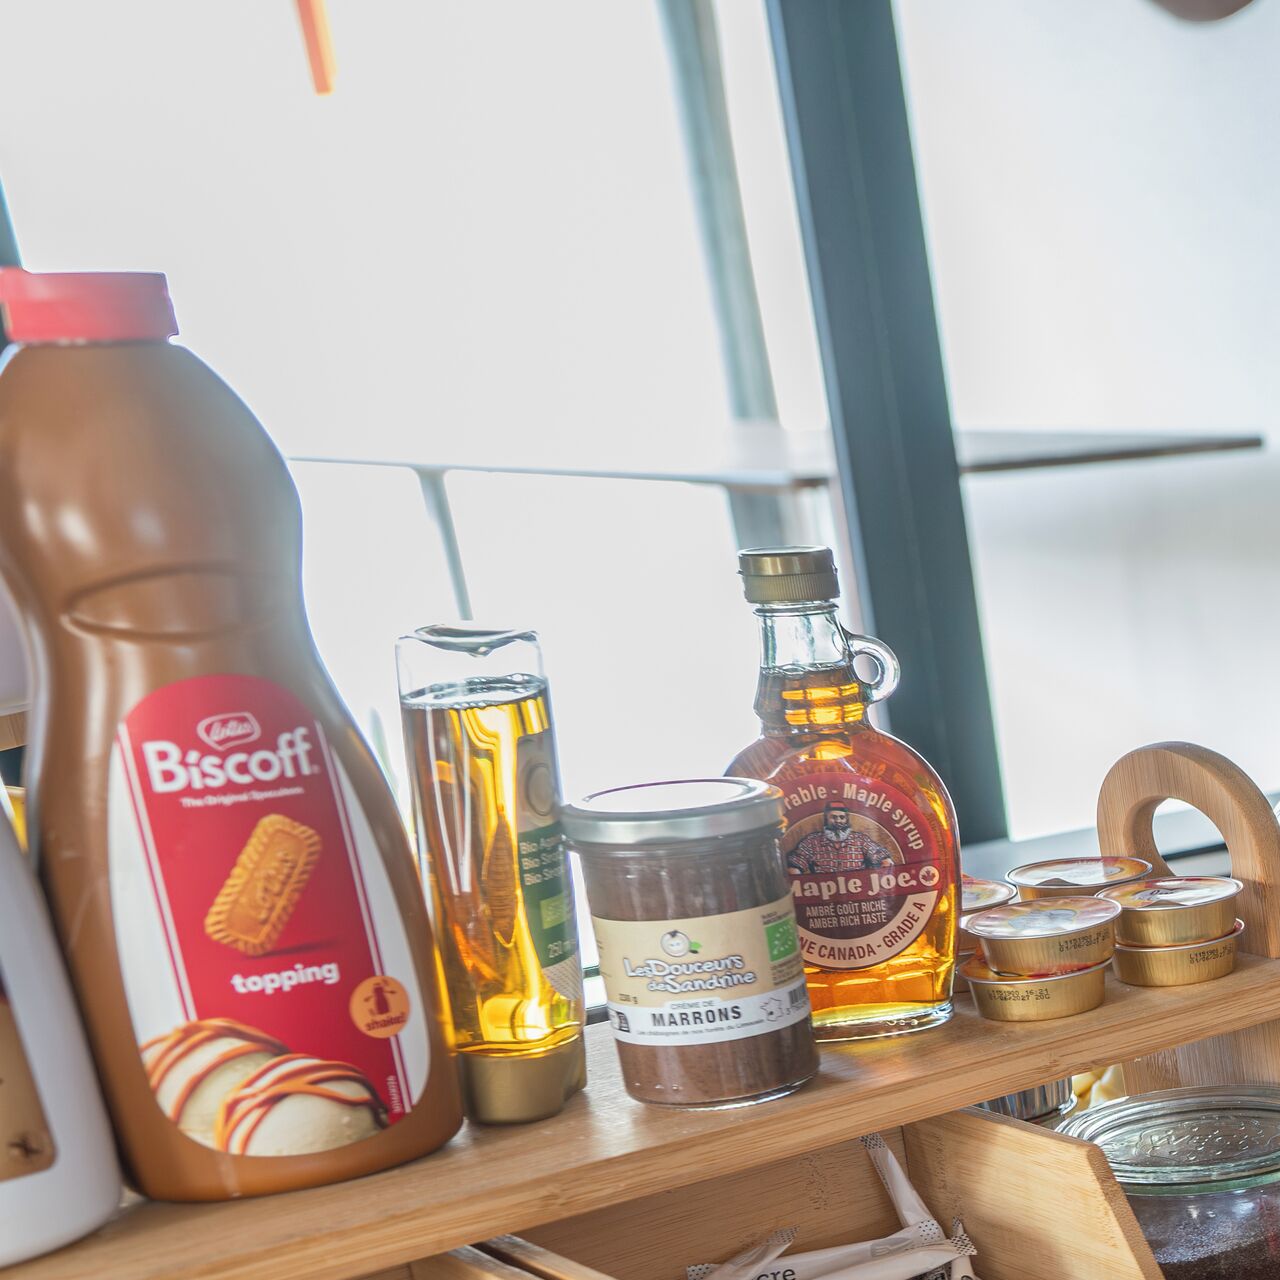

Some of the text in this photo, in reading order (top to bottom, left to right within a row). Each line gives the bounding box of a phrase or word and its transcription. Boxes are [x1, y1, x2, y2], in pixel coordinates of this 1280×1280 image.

[142, 726, 312, 793] Biscoff
[785, 783, 828, 811] rable
[843, 782, 893, 812] Maple
[891, 807, 926, 851] syrup
[866, 871, 918, 897] Joe
[805, 898, 887, 918] AMBRÉ GOÛT RICHE
[808, 915, 838, 930] AMBER
[839, 914, 861, 927] RICH
[861, 911, 888, 926] TASTE
[817, 942, 878, 962] CANADA
[881, 915, 921, 949] GRADE
[912, 899, 927, 914] A
[622, 957, 652, 977] Les
[646, 954, 745, 977] Douceurs
[230, 962, 341, 995] topping
[647, 980, 666, 992] de
[662, 971, 757, 994] Sandrine
[651, 1005, 743, 1027] MARRONS
